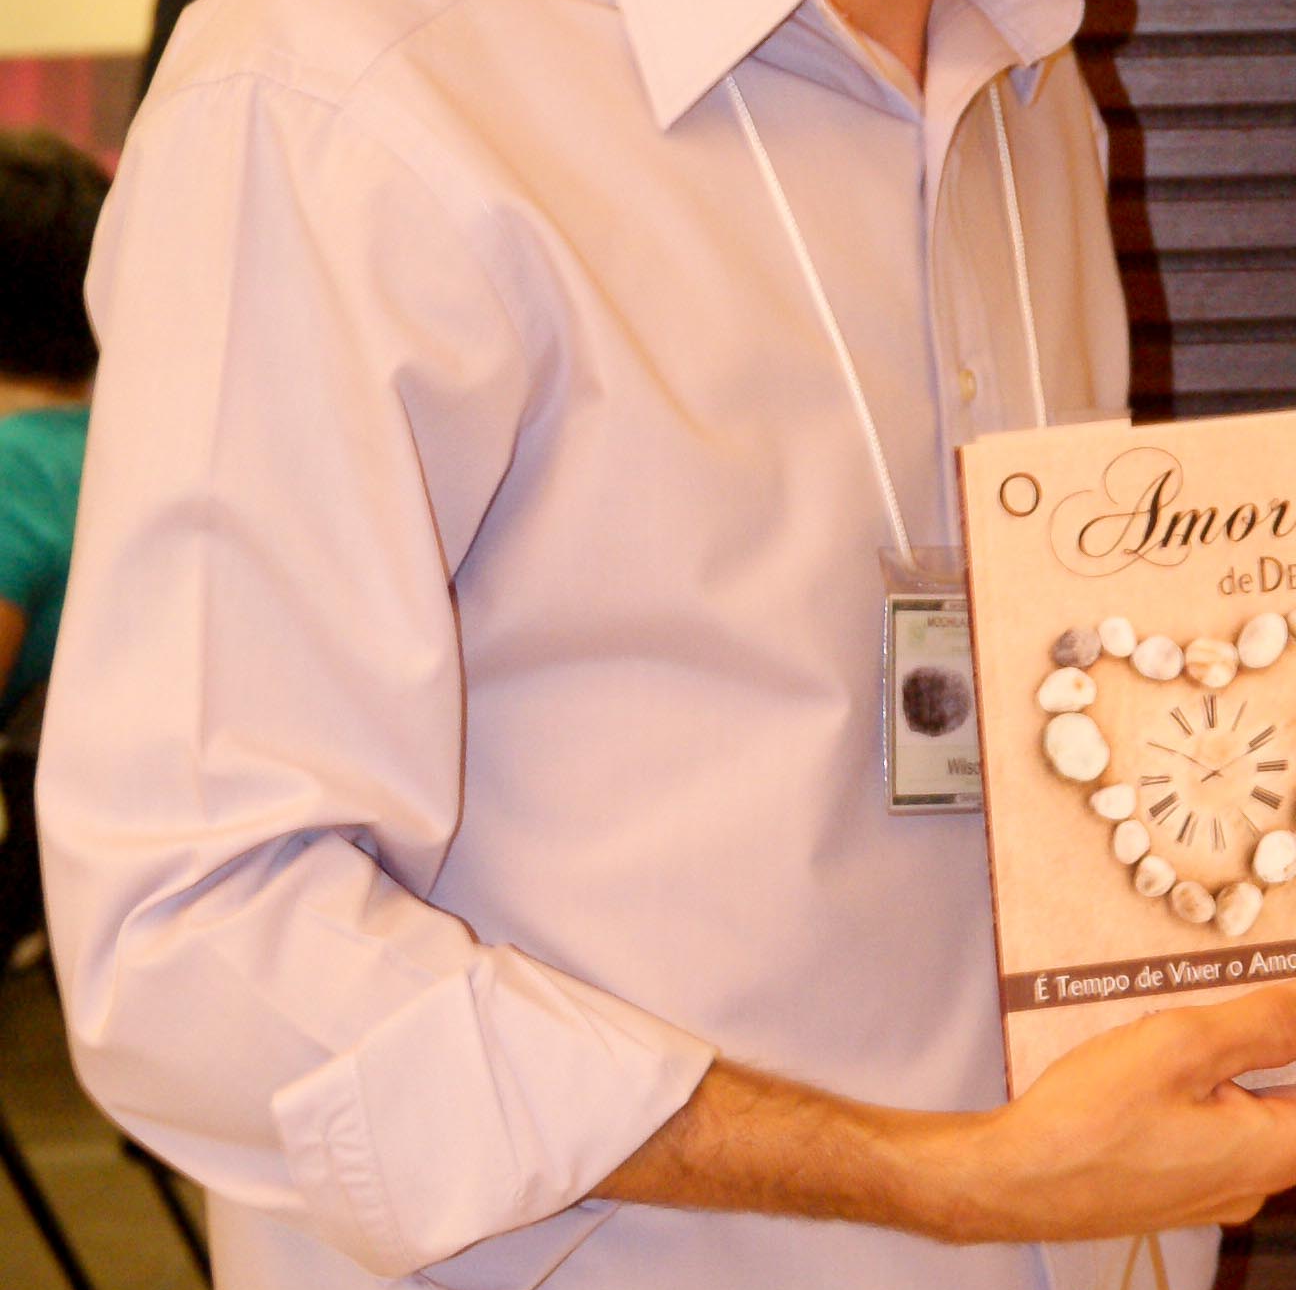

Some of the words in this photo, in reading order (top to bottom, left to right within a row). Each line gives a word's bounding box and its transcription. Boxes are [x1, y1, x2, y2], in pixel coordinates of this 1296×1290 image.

[999, 472, 1042, 518] O
[1218, 566, 1253, 595] de
[1034, 972, 1050, 1001] É
[1056, 971, 1130, 998] Tempo
[1136, 965, 1163, 989] de
[1169, 960, 1220, 985] Viver
[1227, 960, 1242, 978] o
